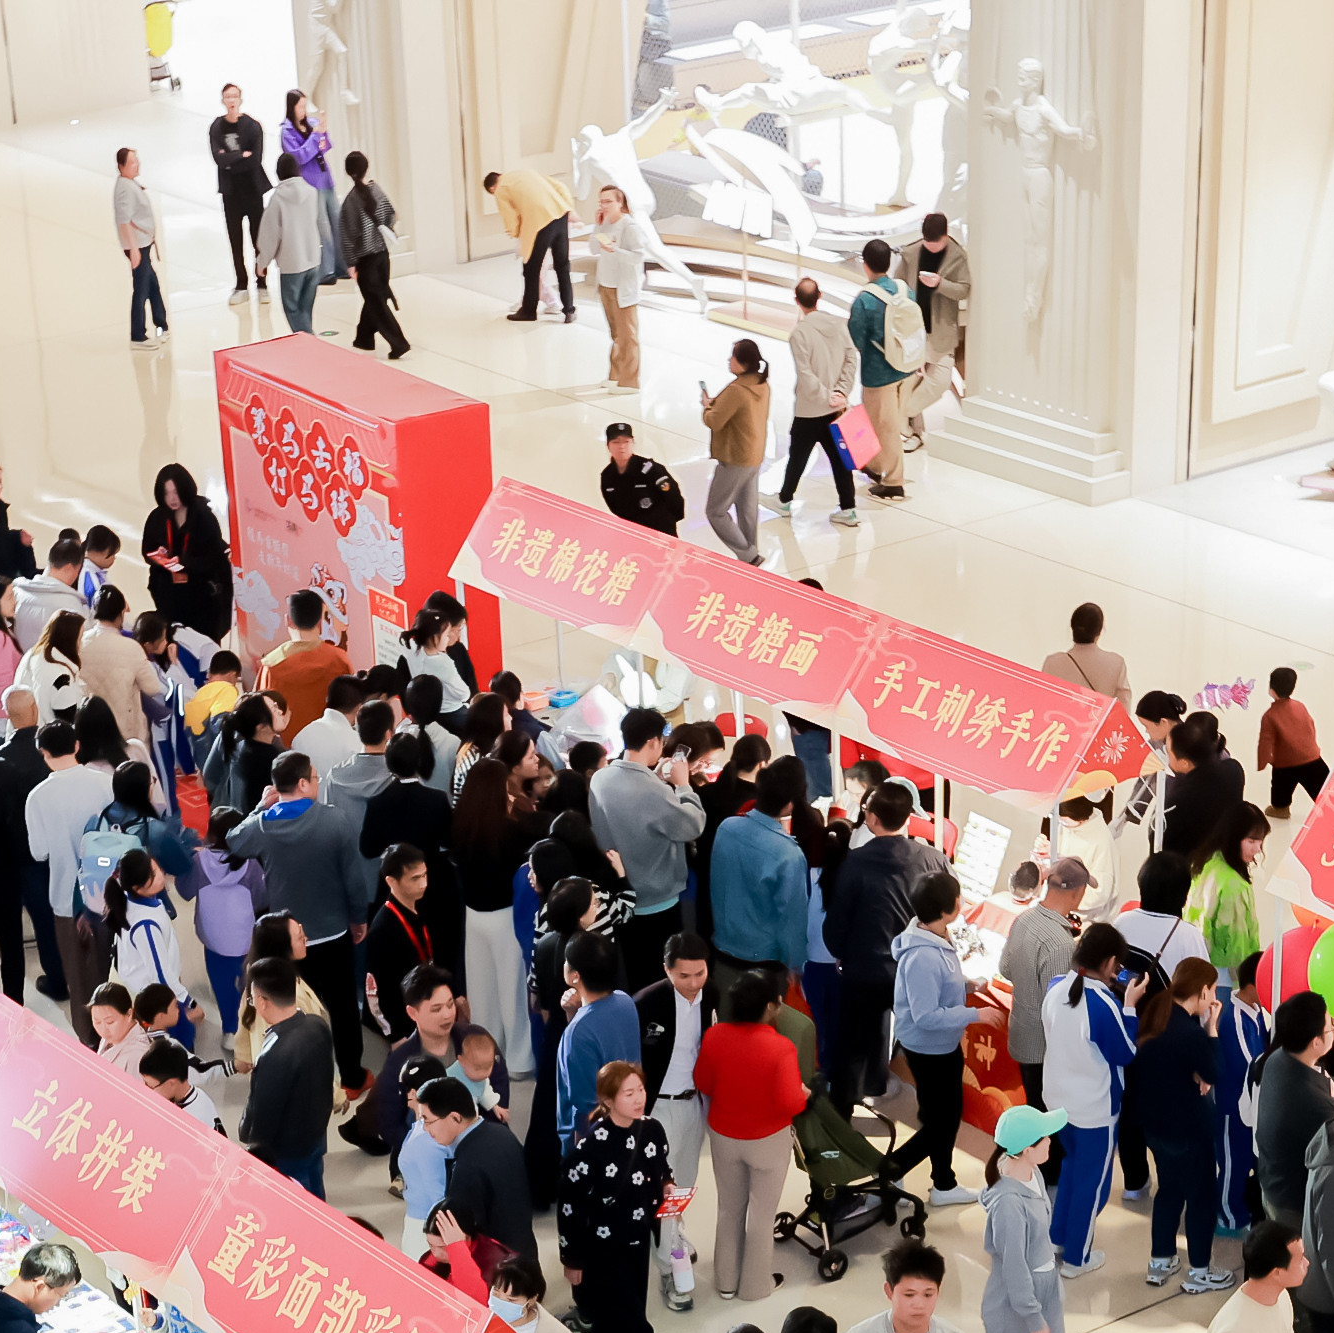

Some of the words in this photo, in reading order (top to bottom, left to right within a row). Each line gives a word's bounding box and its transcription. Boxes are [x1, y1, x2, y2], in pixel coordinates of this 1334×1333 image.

[491, 518, 640, 607] 非遗棉花糖
[686, 592, 821, 678] 非遗糖画
[872, 660, 1071, 773] 手工刺绣手作
